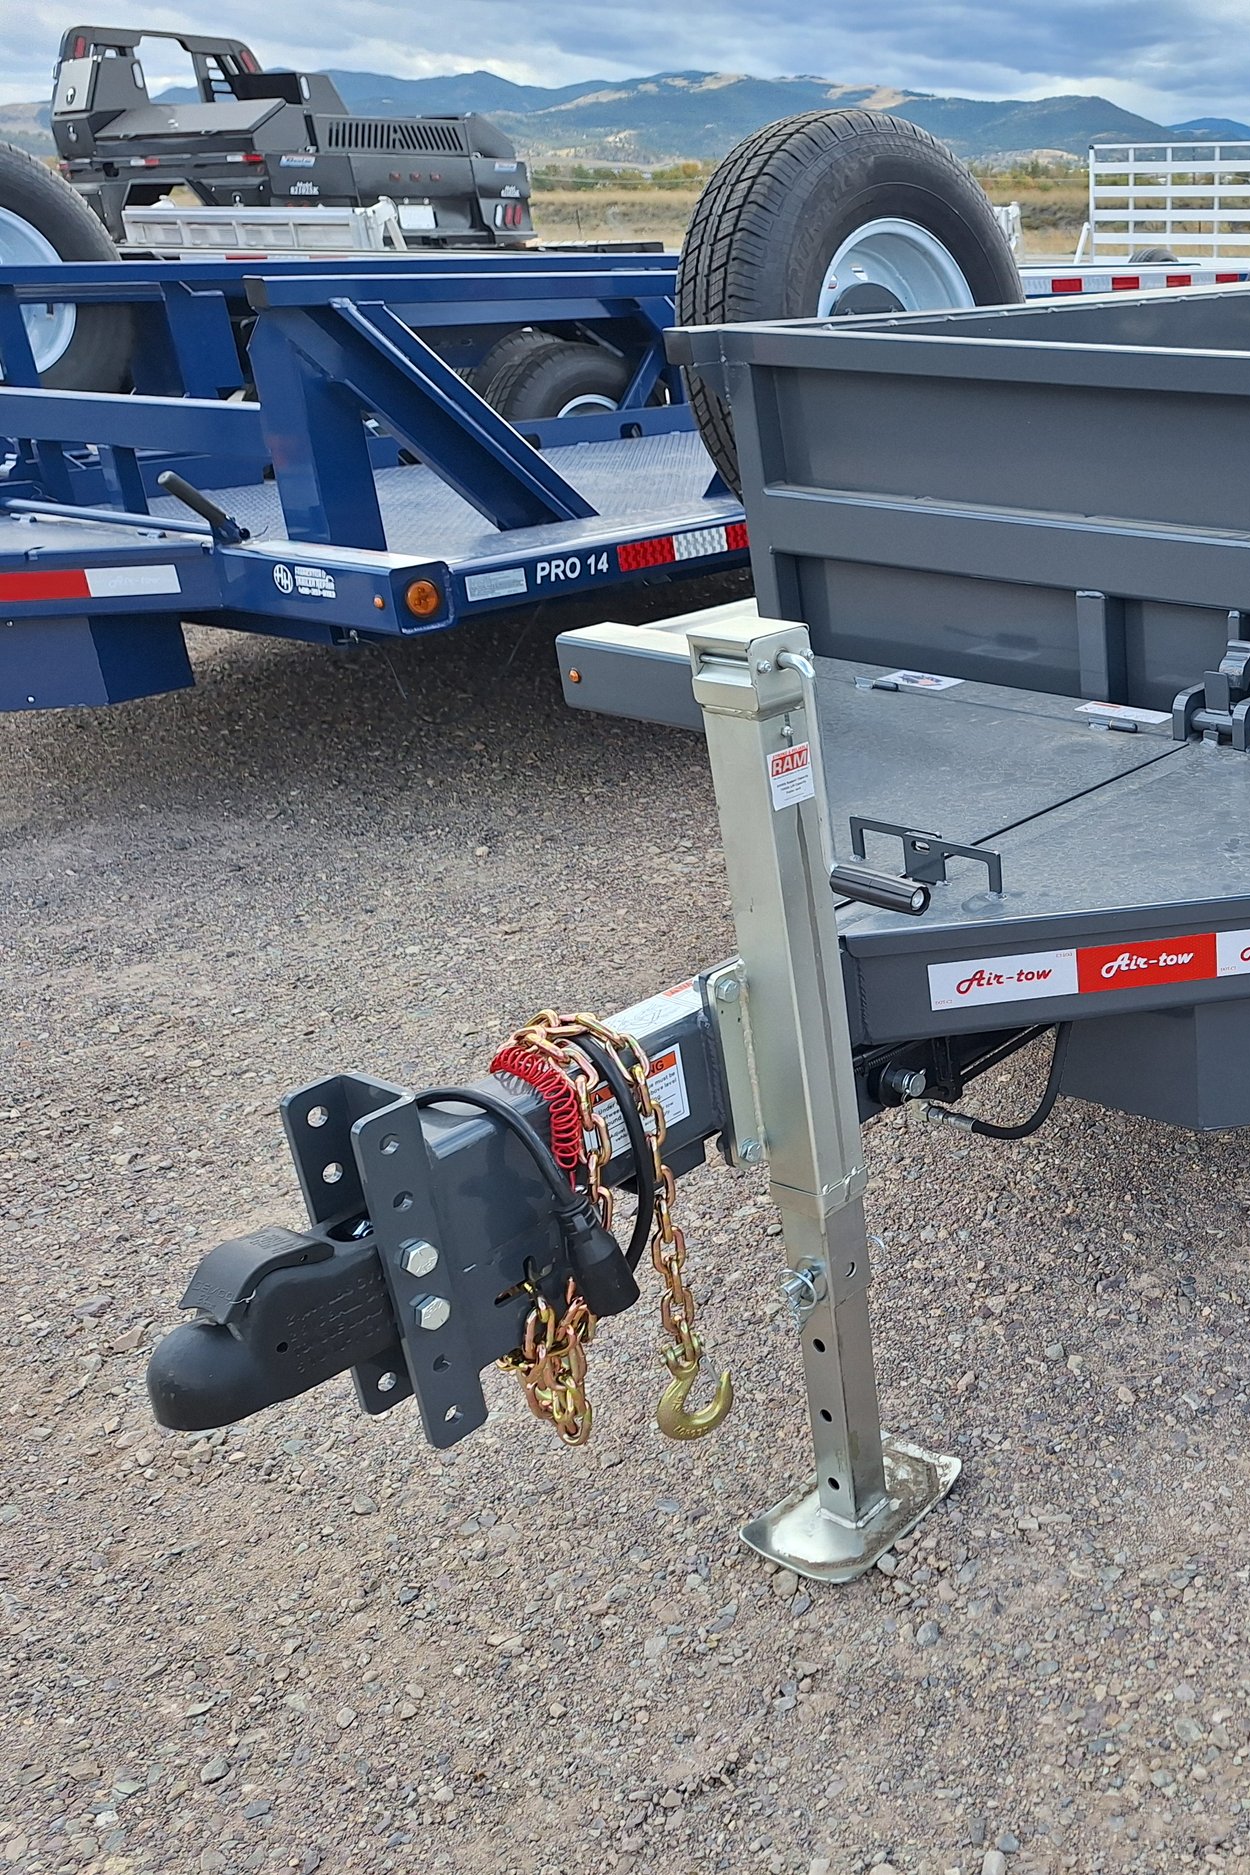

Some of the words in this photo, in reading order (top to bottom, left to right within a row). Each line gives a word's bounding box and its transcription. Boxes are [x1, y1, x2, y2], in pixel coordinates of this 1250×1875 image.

[536, 556, 581, 585] PRO
[587, 551, 609, 575] 14
[772, 751, 807, 776] RAM
[1100, 951, 1194, 979] Air-tow
[956, 968, 1053, 995] Air-tow
[597, 1102, 615, 1115] Under
